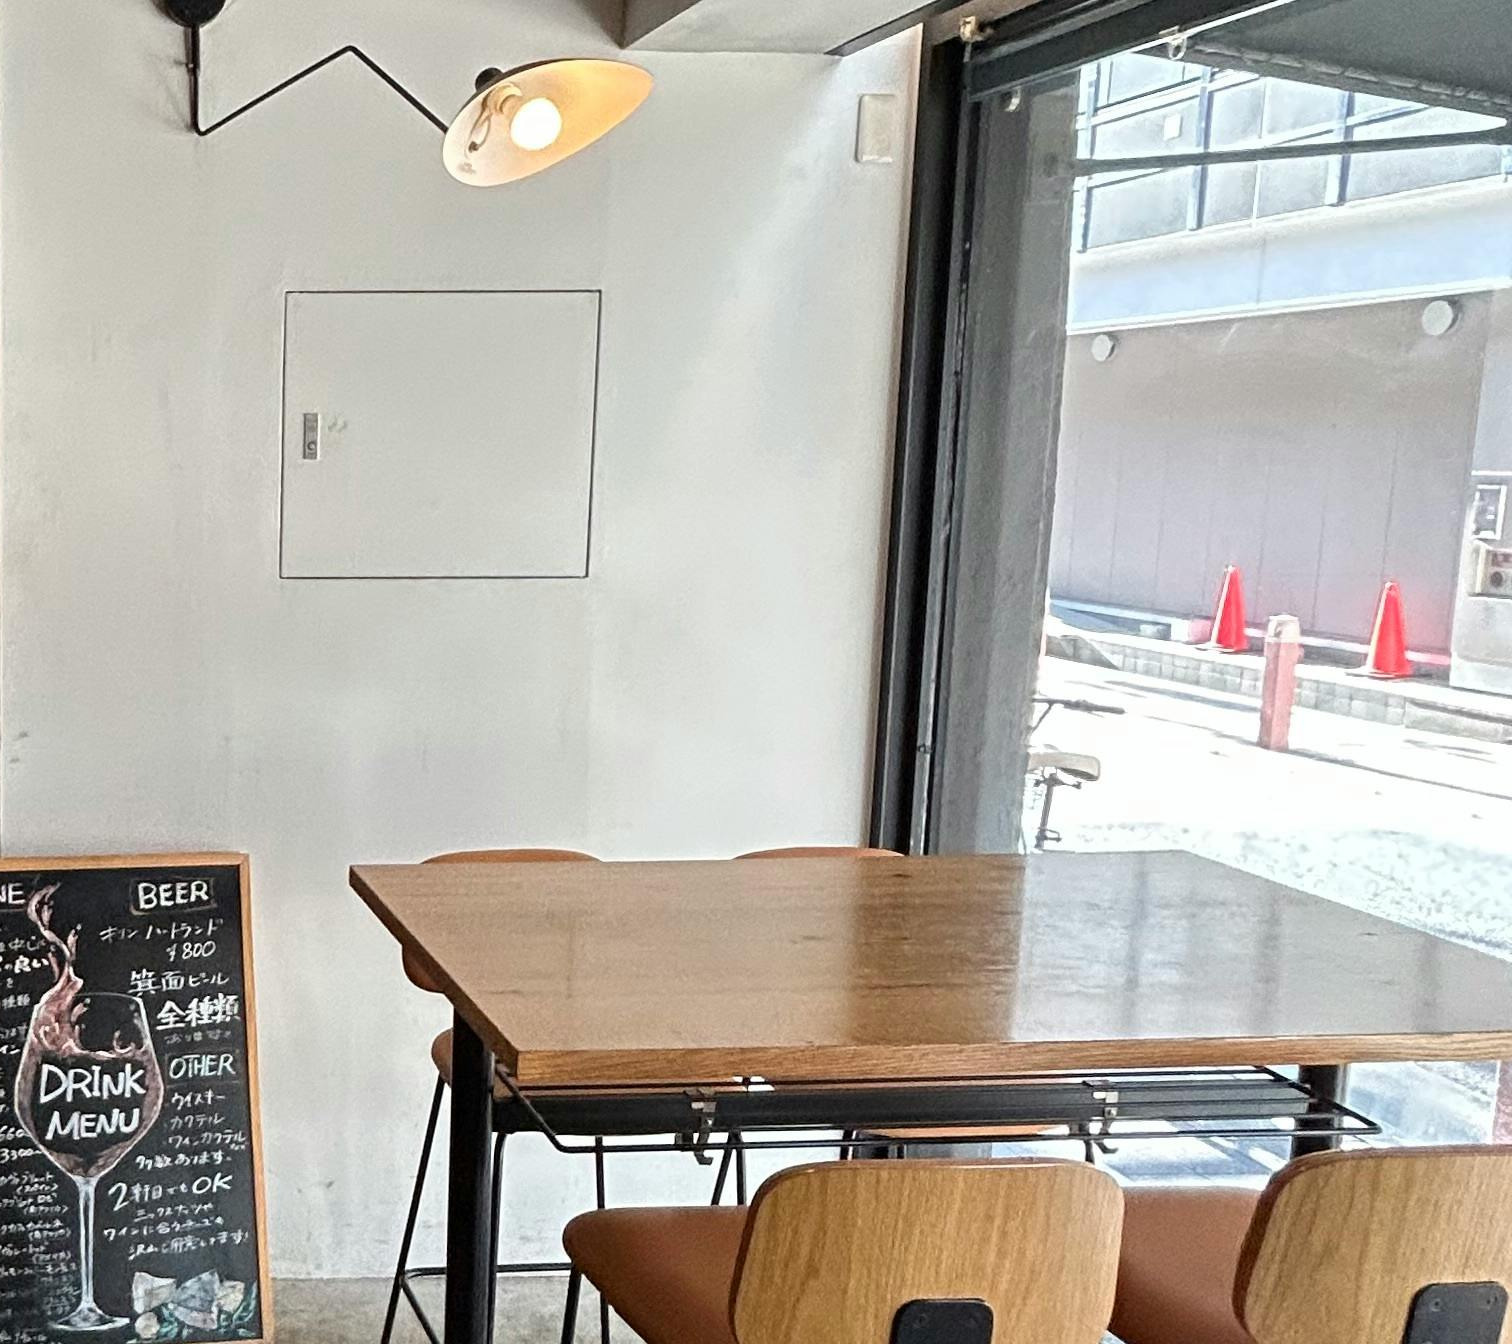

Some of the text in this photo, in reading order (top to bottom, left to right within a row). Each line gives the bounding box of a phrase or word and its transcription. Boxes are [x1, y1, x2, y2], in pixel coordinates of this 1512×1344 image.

[137, 880, 210, 910] BEER
[128, 968, 230, 995] 箕面ビール
[156, 993, 241, 1031] 全種類
[169, 1053, 236, 1079] OTHER
[40, 1063, 147, 1104] DRINK
[45, 1107, 140, 1140] MENU
